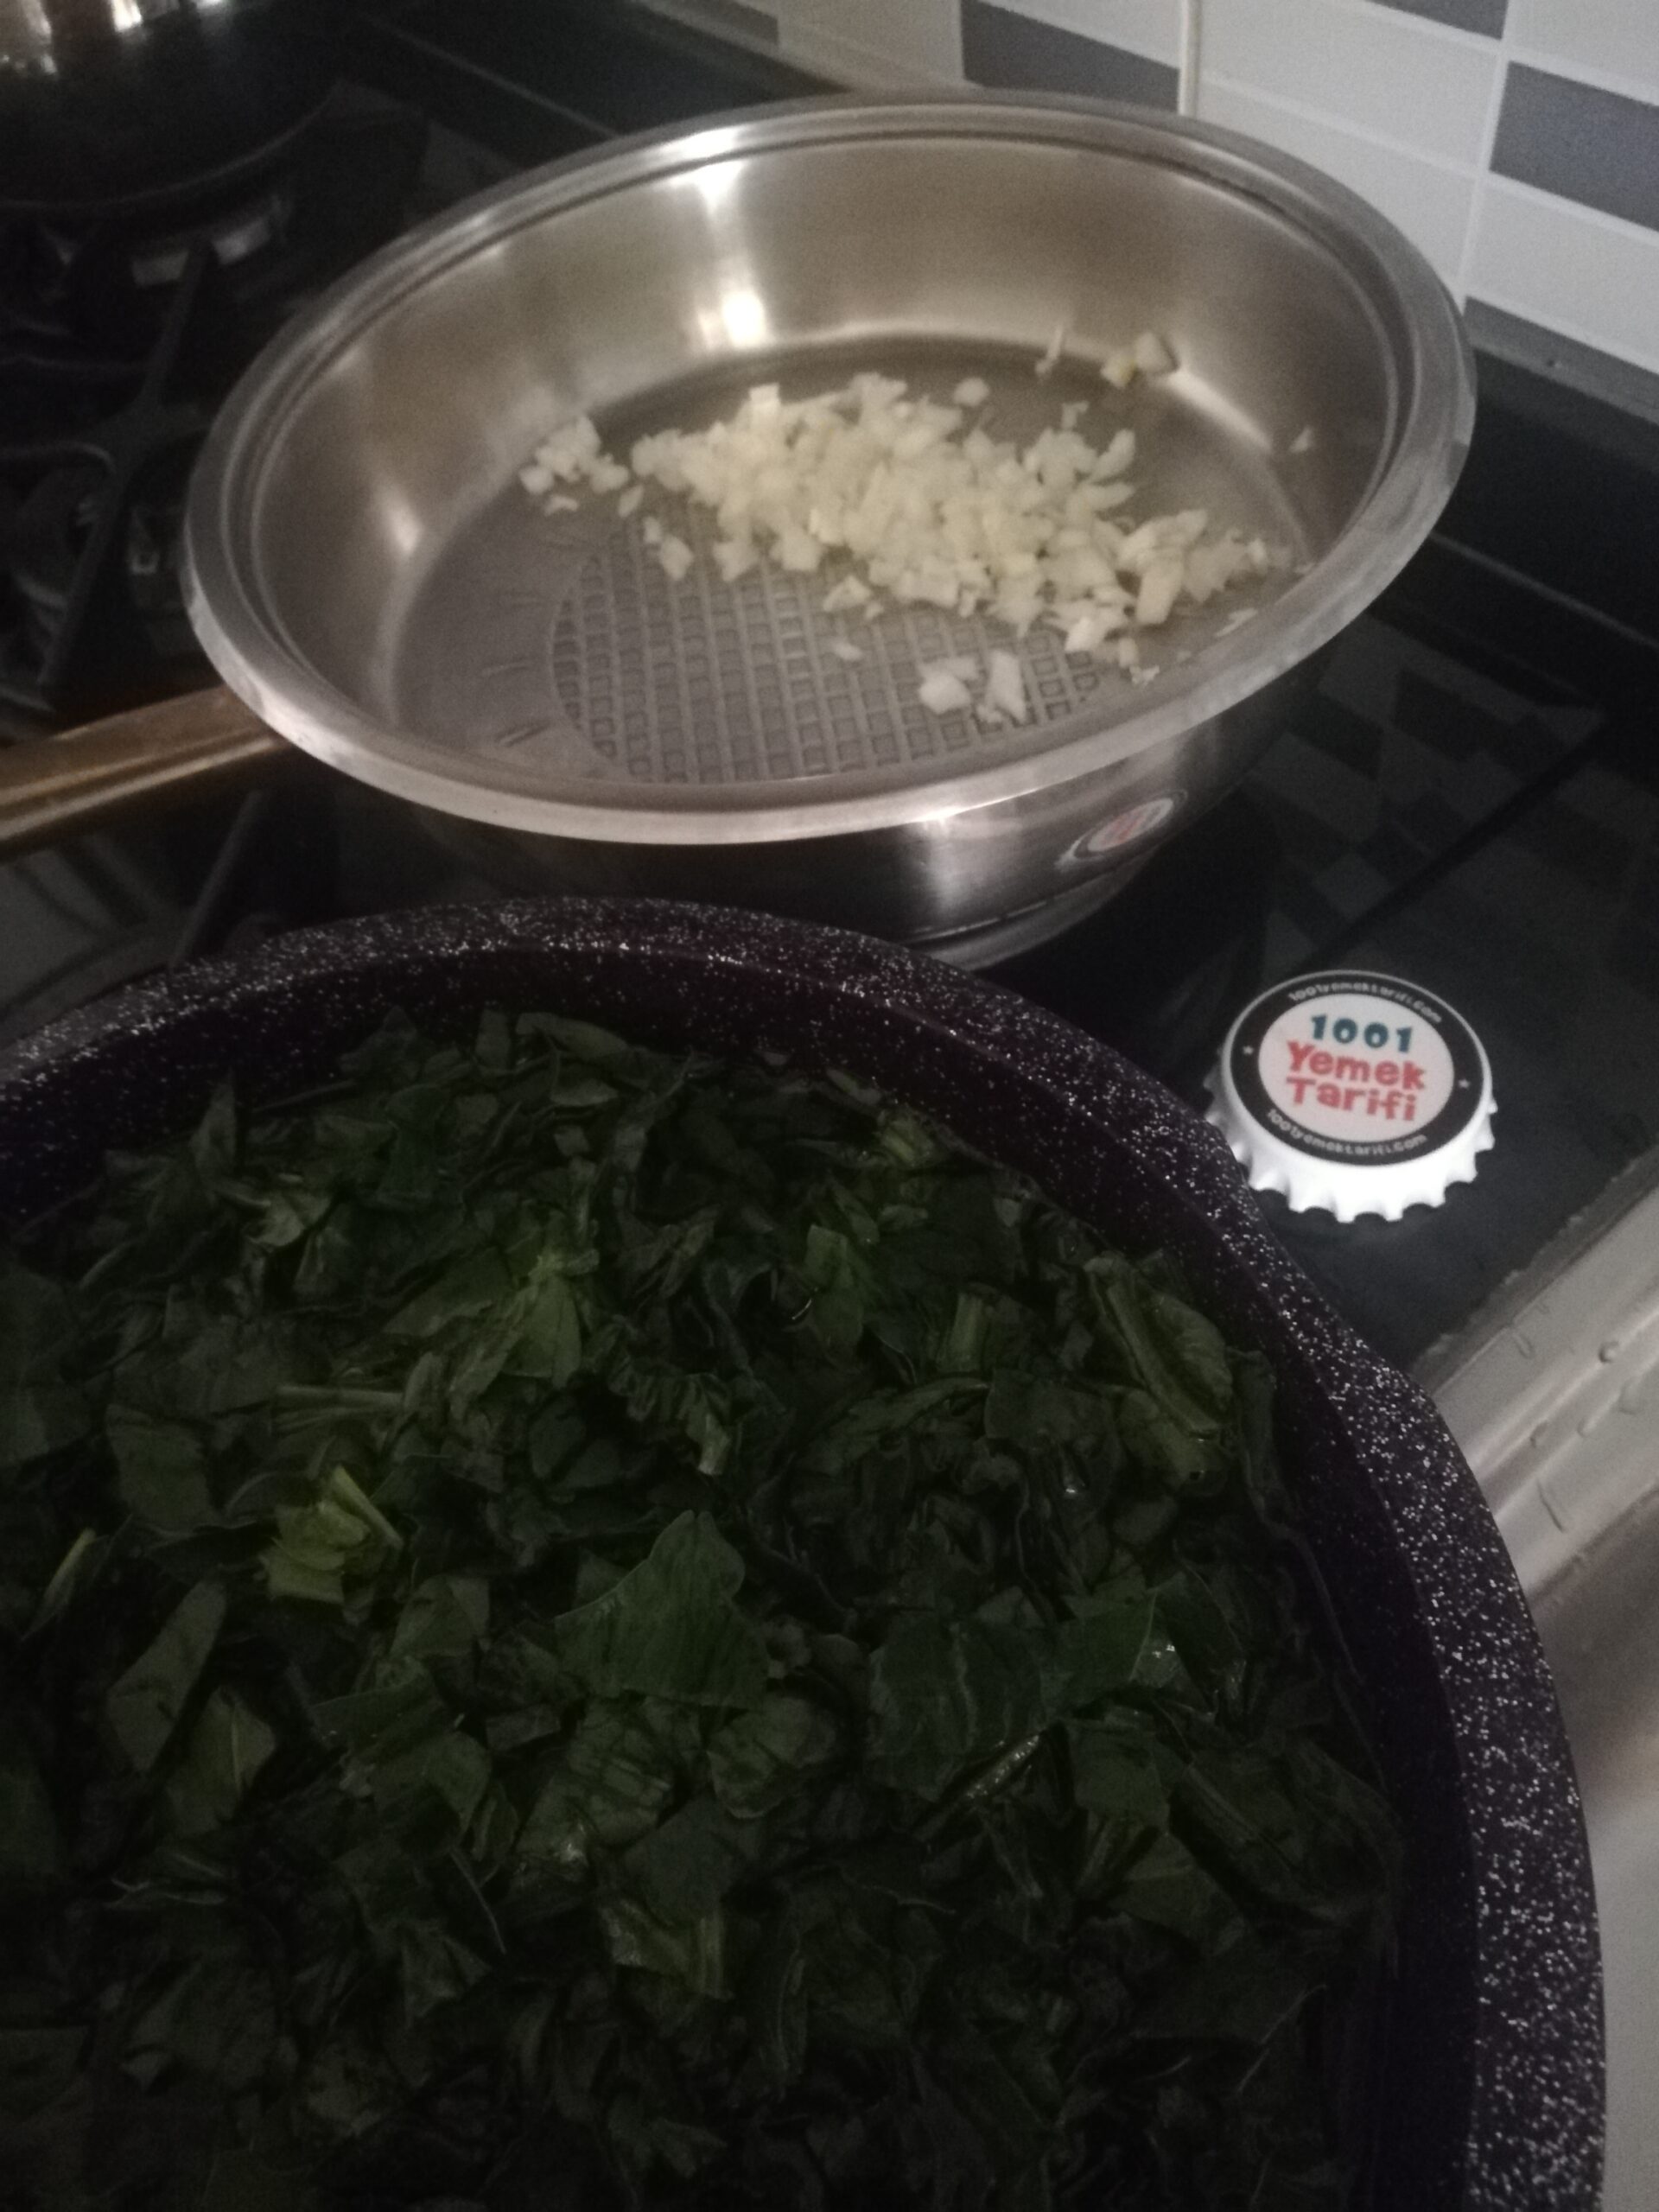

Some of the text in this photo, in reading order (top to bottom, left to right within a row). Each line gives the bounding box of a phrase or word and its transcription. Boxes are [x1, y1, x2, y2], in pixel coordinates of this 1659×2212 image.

[1311, 1014, 1412, 1052] 1001
[1287, 1040, 1426, 1090] Yemek
[1286, 1077, 1417, 1122] Tarifi
